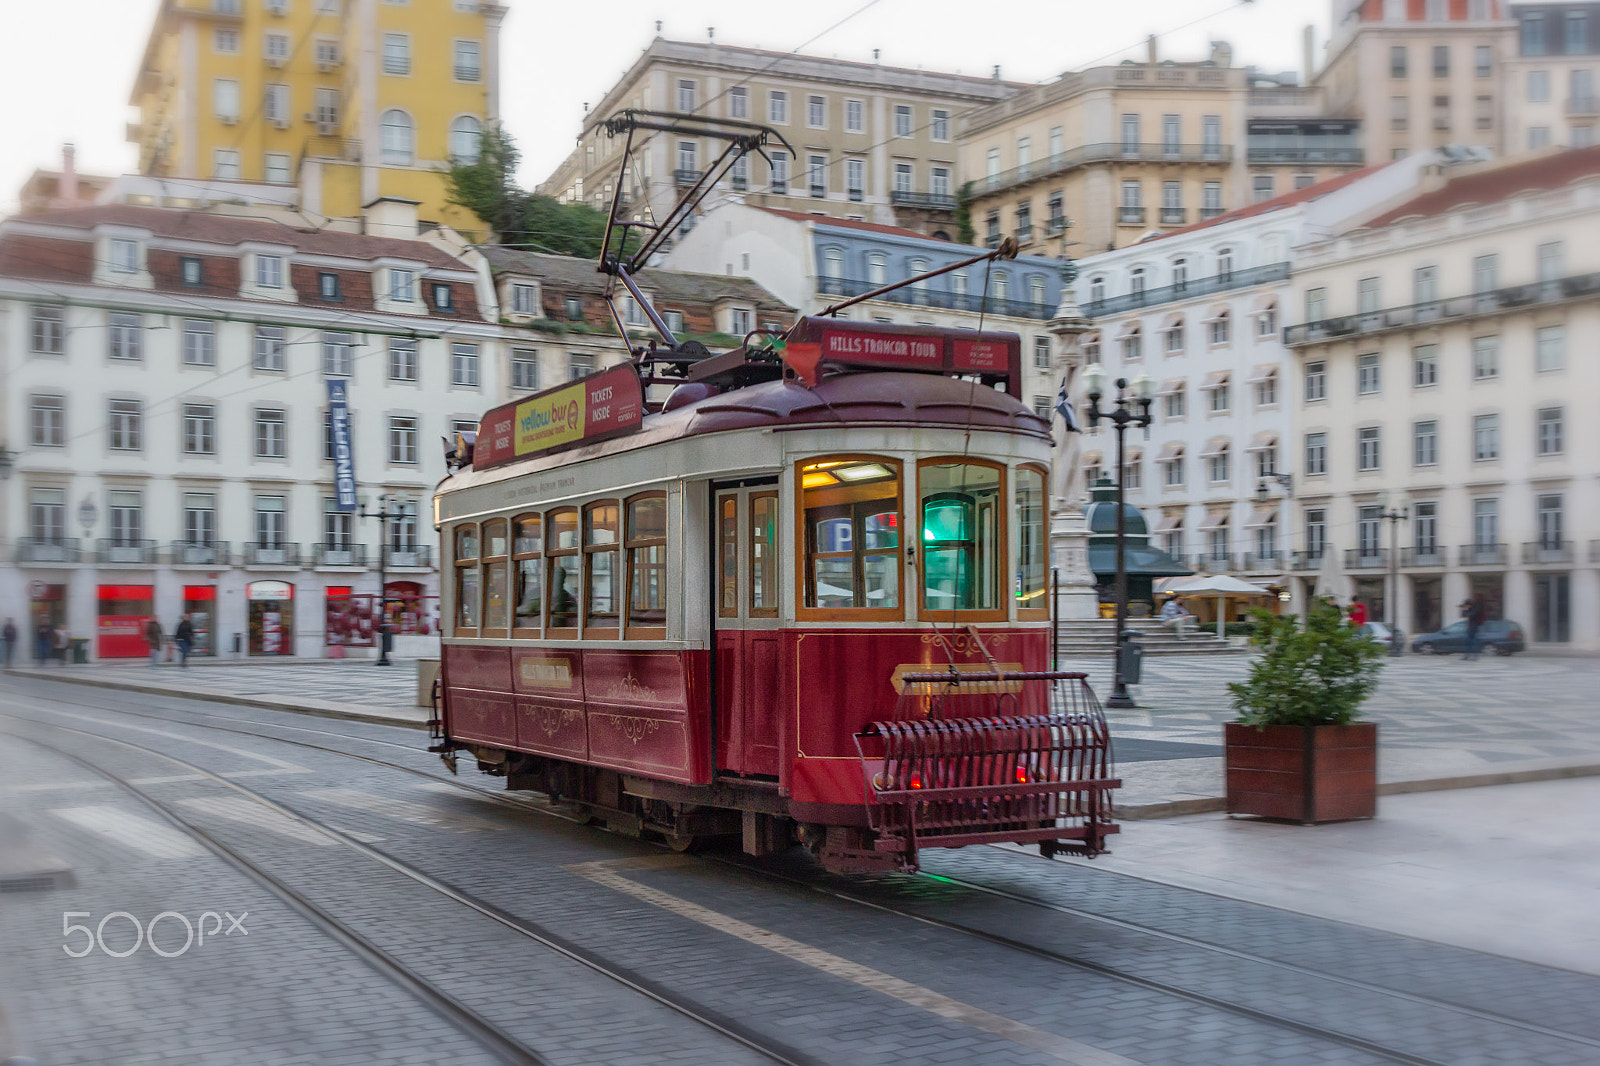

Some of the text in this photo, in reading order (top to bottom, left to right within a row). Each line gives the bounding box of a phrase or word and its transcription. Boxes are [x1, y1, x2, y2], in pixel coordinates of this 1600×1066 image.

[830, 336, 937, 358] HILLS TRAMCAR TOUR
[591, 386, 613, 404] TICKETS
[521, 408, 551, 433] yellow
[592, 405, 611, 422] INSIDE
[494, 419, 512, 435] TICKETS
[495, 436, 510, 451] INSIDE
